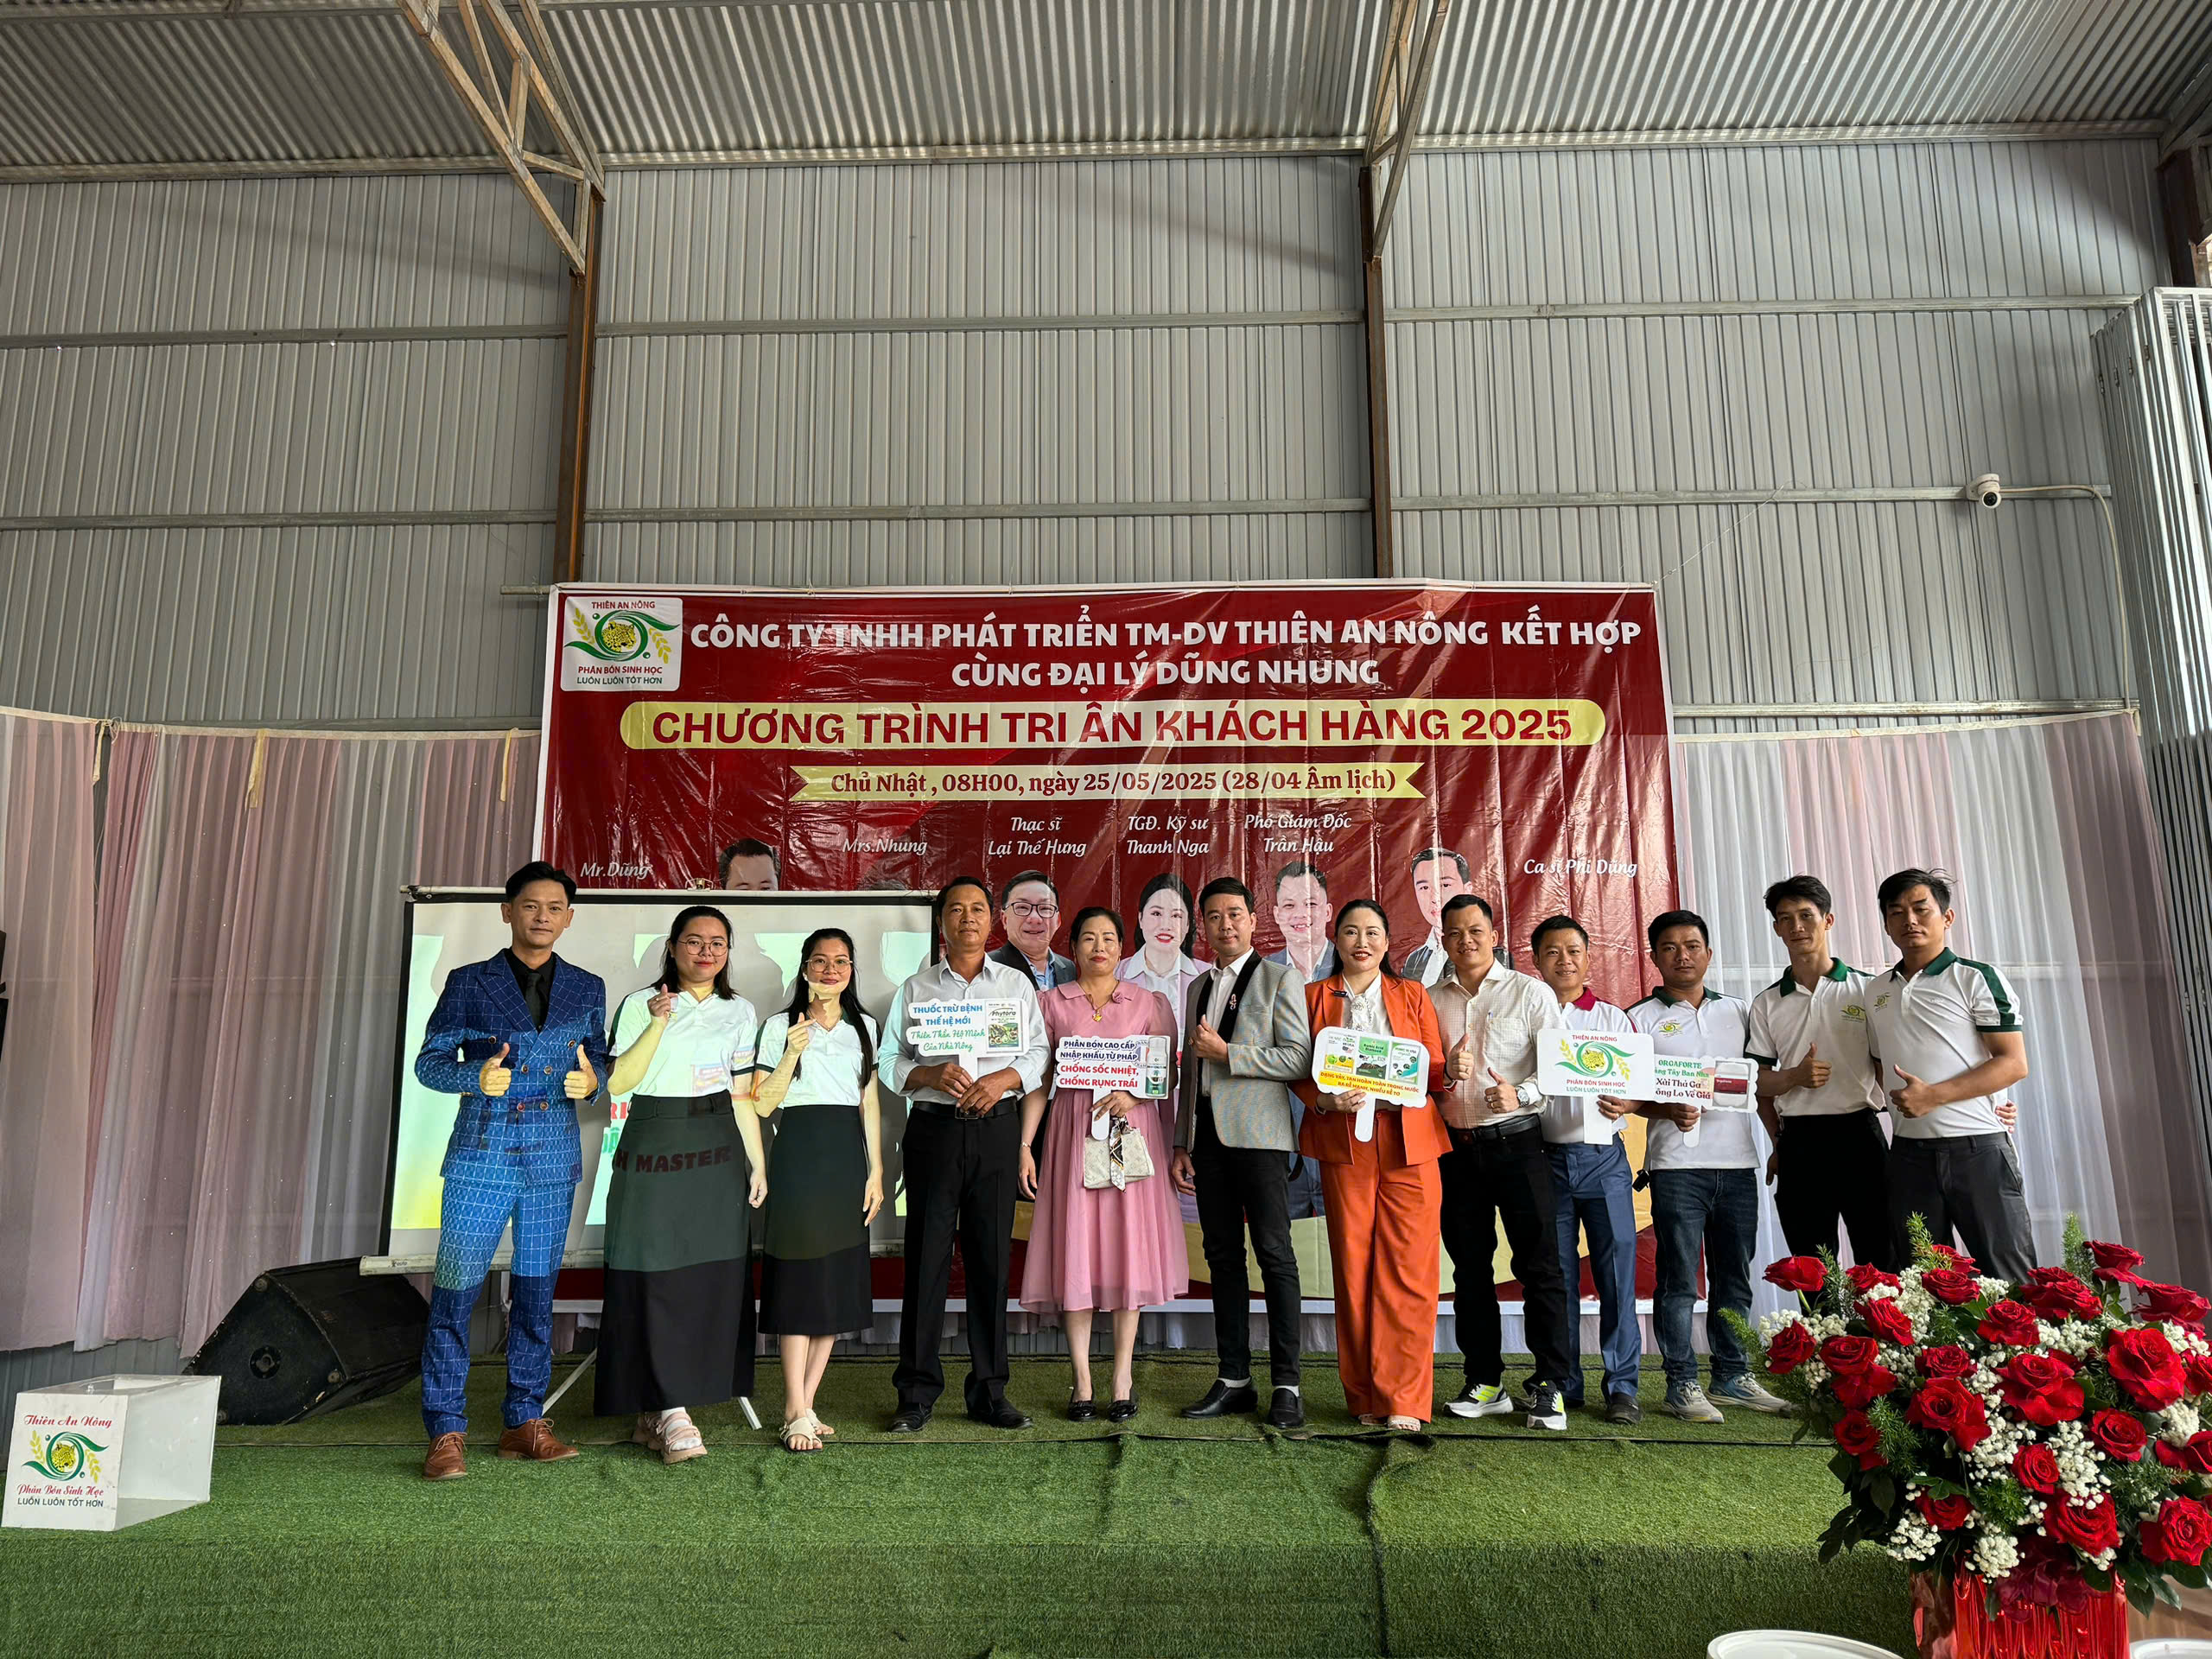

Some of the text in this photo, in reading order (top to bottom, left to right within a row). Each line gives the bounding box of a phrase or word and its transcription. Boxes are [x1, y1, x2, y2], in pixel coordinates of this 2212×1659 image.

[591, 600, 616, 609] THIÊN
[631, 600, 656, 609] NÔNG
[690, 604, 1642, 654] CÔNG TY TNHH PHÁT TRIỂN TM-DV THIÊN AN NÔNG KẾT HỢP
[577, 664, 602, 674] PHÂN
[603, 664, 620, 674] BÓN
[644, 666, 663, 676] HỌC
[951, 650, 1379, 694] CÙNG ĐẠI LÝ DŨNG NHUNG
[602, 676, 624, 684] LUÔN
[652, 700, 1571, 744] CHƯƠNG TRÌNH TRI ÂN KHÁCH HÀNG 2025
[830, 772, 871, 792] Chủ
[875, 772, 927, 798] Nhật
[941, 773, 1026, 796] 08H00,
[1028, 772, 1079, 796] ngày
[1084, 771, 1217, 795] 25/05/2025
[1222, 769, 1302, 794] (28/04
[1305, 766, 1343, 790] Âm
[1347, 768, 1396, 794] lịch)
[1009, 816, 1063, 835] Thạc sĩ
[1127, 814, 1210, 833] TGĐ. Kỹ sư
[1243, 810, 1352, 830] Phó Giám Đốc
[841, 837, 929, 856] Mrs.Nhung
[988, 836, 1087, 859] Lại Thế Hưng
[1126, 839, 1210, 857] Thanh Nga
[1262, 834, 1335, 855] Trần Hậu
[580, 861, 649, 880] Mr.Dũng
[1523, 859, 1546, 874] Ca
[1565, 859, 1592, 874] Phi
[1596, 860, 1638, 878] Dũng
[912, 1002, 983, 1014] THUỐC TRỪ BỆNH
[925, 1014, 971, 1027] THẾ HỆ MỚI
[952, 1029, 965, 1039] Hộ
[923, 1041, 938, 1052] Của
[954, 1041, 974, 1052] Nông
[1086, 1039, 1103, 1049] BÓN
[1120, 1039, 1135, 1049] CẤP
[1060, 1051, 1082, 1060] NHẬP
[1105, 1050, 1116, 1059] TỪ
[1116, 1051, 1138, 1060] PHÁP
[1060, 1062, 1091, 1073] CHỐNG
[1092, 1063, 1109, 1074] SỐC
[1110, 1065, 1139, 1076] NHIỆT,
[1658, 1059, 1702, 1069] ORGAFORTE
[1667, 1068, 1681, 1077] Tây
[1059, 1074, 1138, 1089] CHỐNG RỤNG TRÁI
[1688, 1080, 1701, 1089] Ga
[1673, 1089, 1684, 1097] Lo
[1695, 1090, 1712, 1100] Giá
[635, 1146, 732, 1173] MASTER
[23, 1414, 112, 1429] Thiên An Nông
[63, 1484, 84, 1496] Sinh
[17, 1496, 104, 1508] LUÔN LUÔN TỐT HƠN
